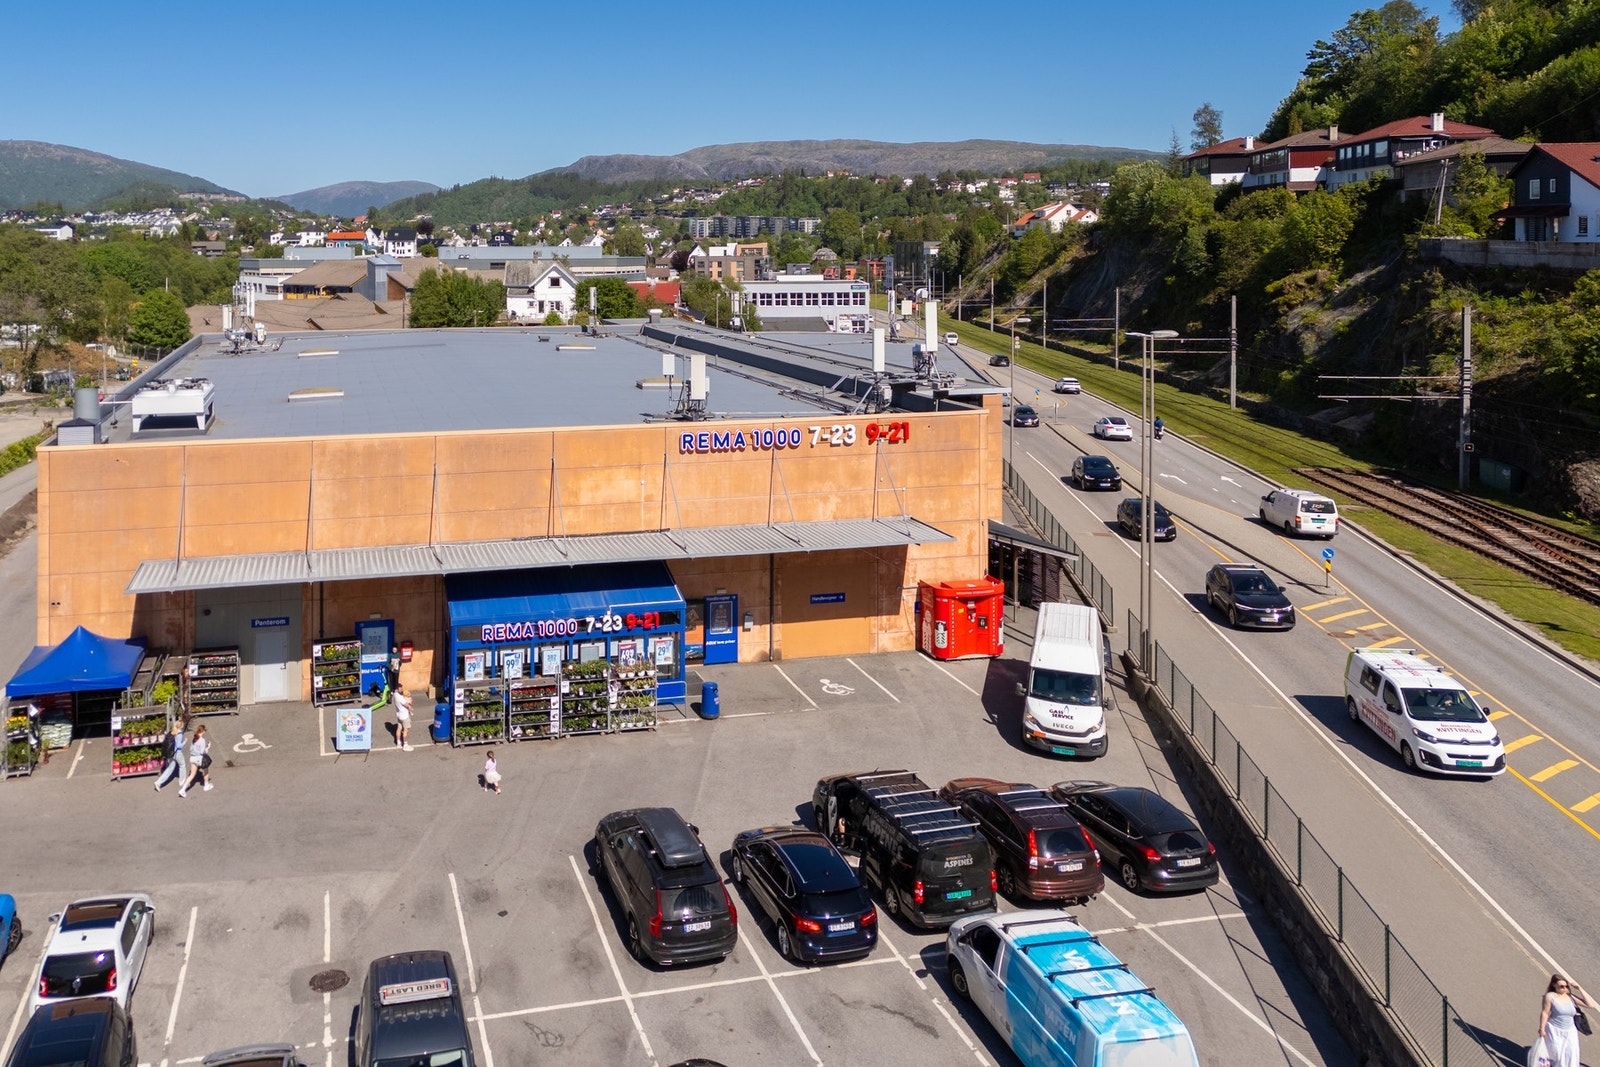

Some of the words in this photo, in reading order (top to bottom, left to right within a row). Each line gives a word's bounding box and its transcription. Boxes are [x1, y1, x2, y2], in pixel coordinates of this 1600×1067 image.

[680, 430, 746, 452] REMA
[752, 427, 802, 448] 1000
[808, 424, 857, 447] 7-23
[866, 422, 910, 443] 9-21
[482, 622, 535, 641] REMA
[538, 618, 578, 636] 1000
[586, 614, 623, 633] 7-23
[626, 612, 661, 630] 9-21
[1052, 713, 1074, 721] SERVICE
[1436, 727, 1482, 735] KVITTINGEN
[944, 857, 974, 868] ASPENES
[391, 987, 414, 995] LAST
